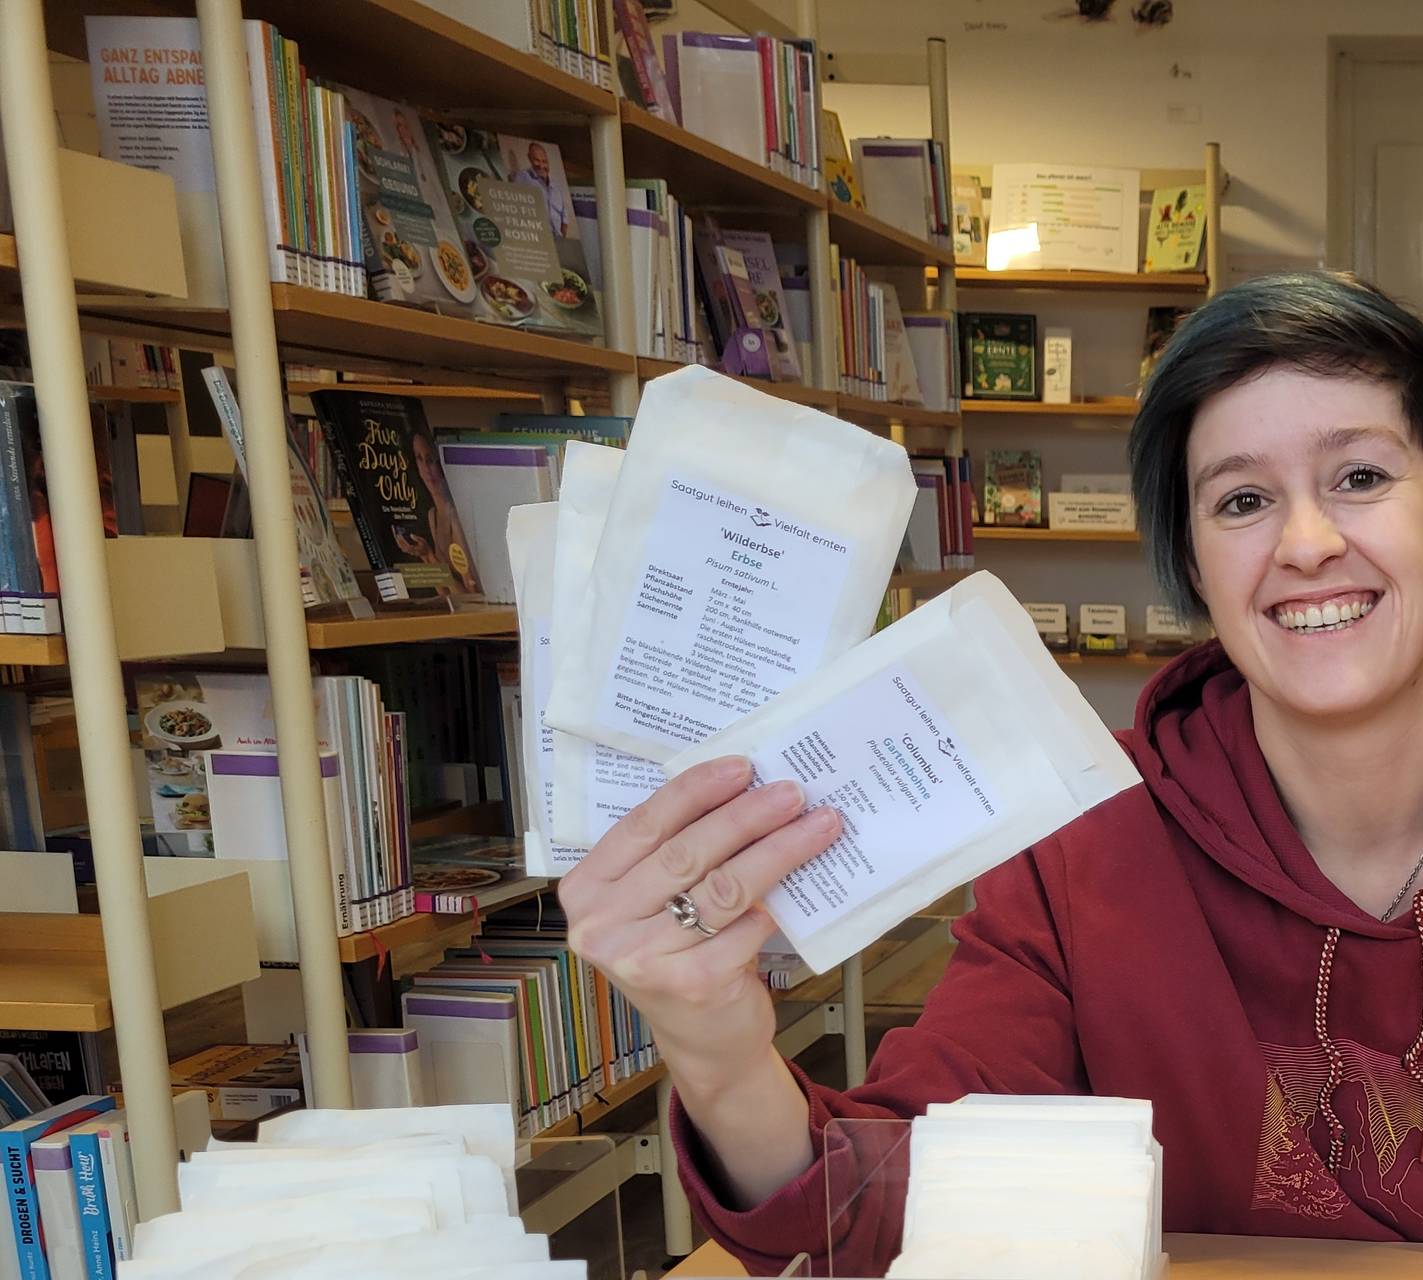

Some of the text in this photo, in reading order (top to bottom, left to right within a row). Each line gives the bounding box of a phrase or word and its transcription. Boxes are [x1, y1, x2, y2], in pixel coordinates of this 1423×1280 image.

[102, 49, 138, 64] GANZ
[104, 67, 206, 85] ALLTAG ABNE
[489, 187, 536, 205] GESUND
[504, 215, 544, 231] FRANK
[363, 418, 400, 446] Five
[358, 442, 409, 479] Days
[374, 471, 418, 510] Only
[671, 479, 846, 554] Saatgut leihen Vielfalt ernten
[721, 527, 784, 559] 'Wilderbse'
[705, 557, 733, 573] Pisum
[733, 569, 769, 587] sativum
[731, 550, 762, 569] Erbse
[645, 573, 693, 595] Pflanzabstand
[648, 564, 683, 582] Direktsaat
[639, 591, 684, 612] Küchenernte
[643, 582, 682, 601] Wuchshöhe
[636, 600, 678, 620] Samenernte
[705, 605, 718, 615] 200
[699, 623, 711, 632] Die
[719, 621, 744, 634] August
[625, 636, 637, 645] Die
[685, 657, 717, 674] Wilderbse
[697, 651, 724, 666] Wochen
[622, 646, 635, 654] mit
[643, 652, 672, 667] Getreide
[719, 681, 733, 689] und
[740, 688, 756, 697] dem
[616, 692, 633, 702] Bitte
[634, 698, 660, 712] bringen
[660, 708, 671, 716] Sie
[615, 701, 631, 711] Korn
[668, 721, 682, 729] und
[681, 726, 694, 734] mit
[694, 730, 708, 738] den
[892, 676, 995, 816] Saatgut leihen Vielfalt ernten
[902, 732, 943, 784] 'Columbus'
[866, 739, 918, 805] Phaseolus vulgaris
[882, 737, 930, 800] Gartenbohne
[337, 873, 350, 930] Ernährung
[8, 1147, 34, 1245] DROGEN & SUCHT
